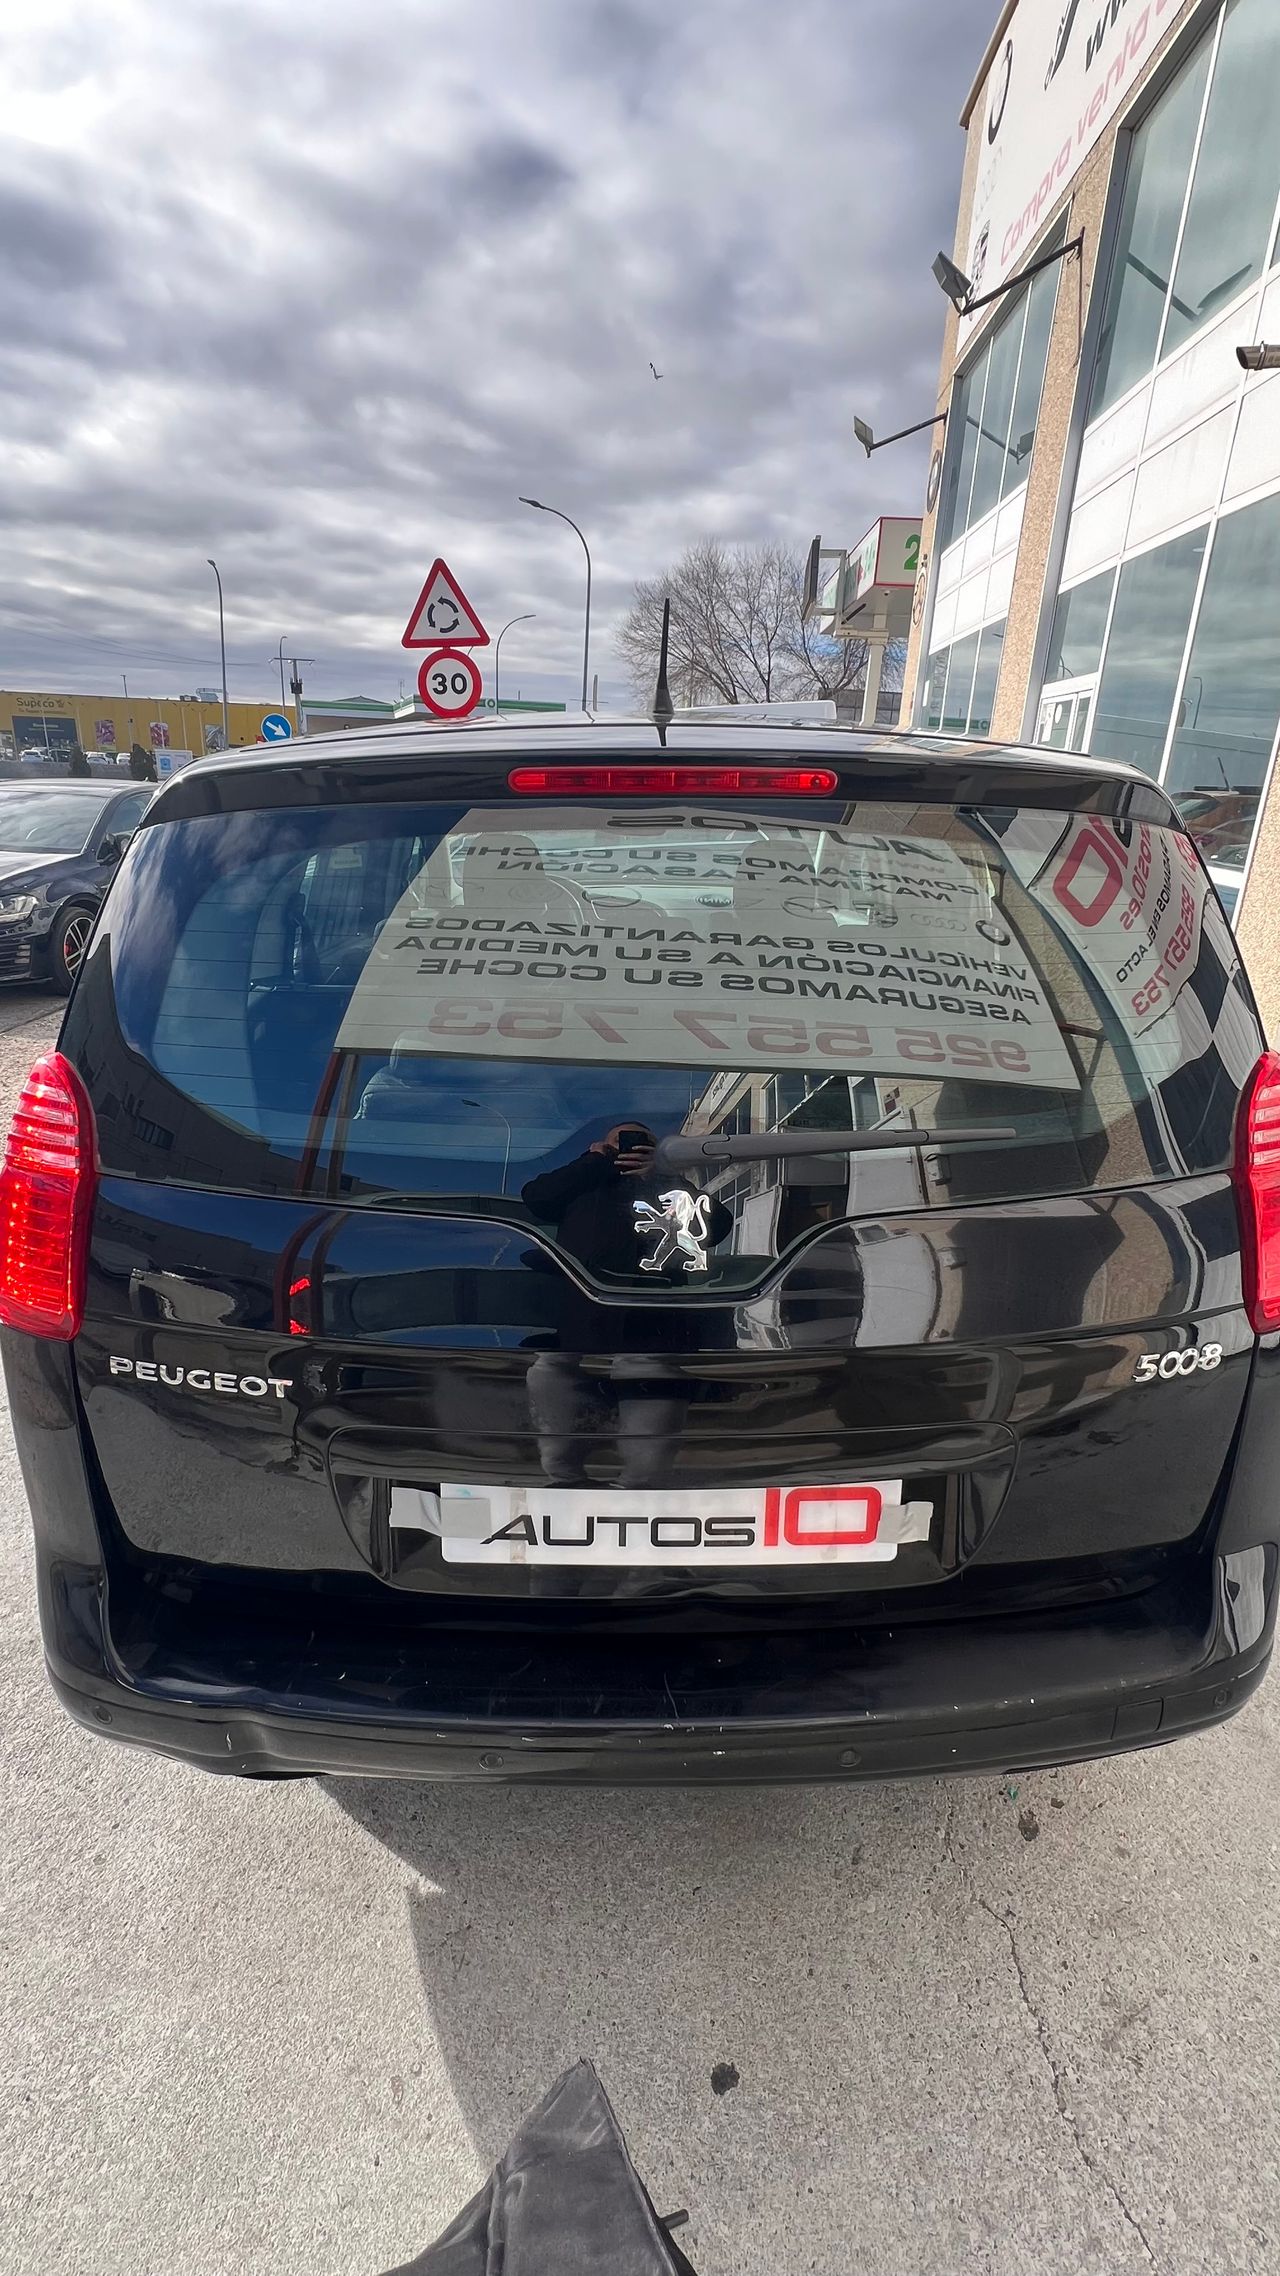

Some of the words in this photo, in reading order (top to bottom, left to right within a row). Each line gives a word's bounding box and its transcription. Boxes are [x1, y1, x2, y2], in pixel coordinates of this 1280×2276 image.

[432, 673, 468, 695] 30
[109, 1355, 294, 1399] PEUGEOT
[1132, 1343, 1223, 1382] 5008
